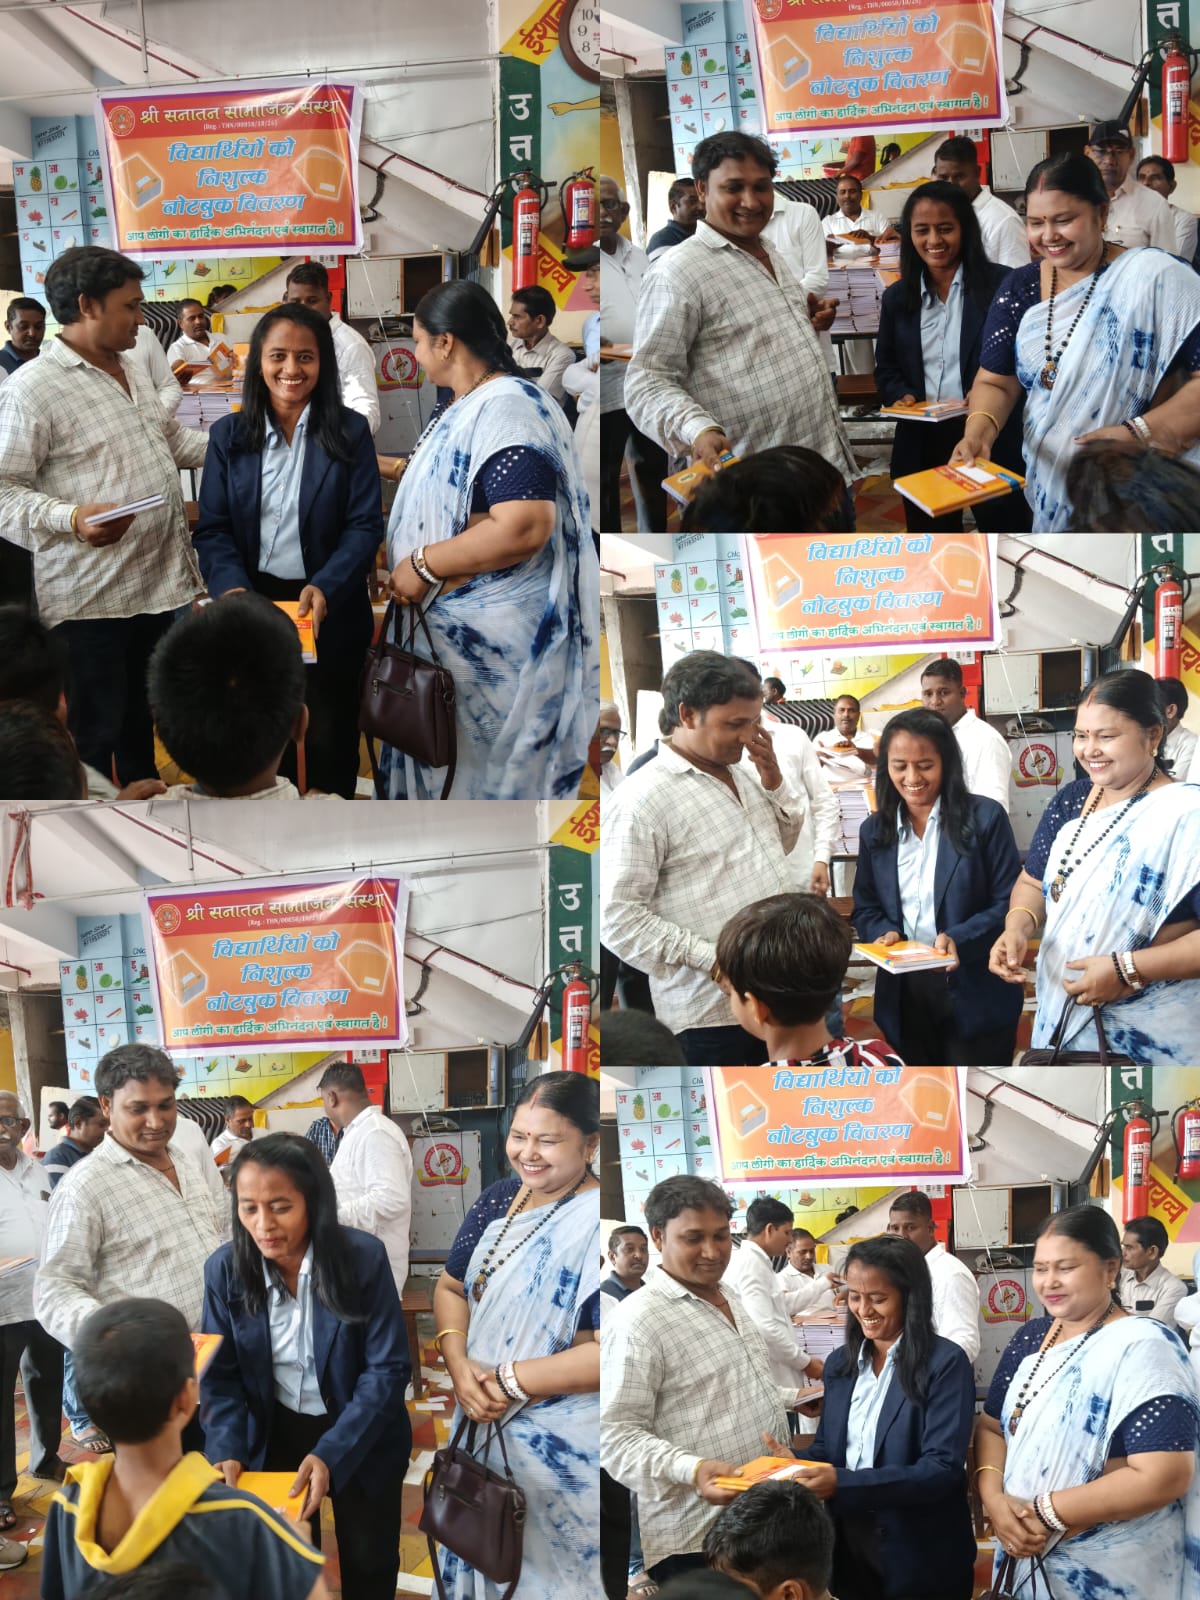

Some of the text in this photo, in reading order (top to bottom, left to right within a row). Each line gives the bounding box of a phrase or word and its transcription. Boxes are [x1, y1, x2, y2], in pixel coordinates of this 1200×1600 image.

[583, 9, 593, 20] 10
[913, 12, 940, 34] को
[578, 25, 587, 36] 9
[582, 41, 590, 52] 8
[593, 53, 600, 64] 7
[844, 47, 912, 70] निशुल्क
[810, 70, 950, 98] नोटबुक वितरण
[140, 106, 159, 124] श्री
[164, 108, 220, 122] सनातन
[819, 109, 834, 118] का
[837, 105, 867, 118] हार्दिक
[937, 99, 970, 110] स्वागत
[269, 137, 296, 157] को
[196, 167, 268, 191] निशुल्क
[161, 192, 306, 219] नोटबुक वितरण
[172, 229, 186, 239] का
[189, 225, 221, 240] हार्दिक
[292, 223, 326, 235] स्वागत
[906, 534, 933, 554] को
[836, 565, 905, 588] निशुल्क
[801, 590, 944, 617] नोटबुक वितरण
[811, 628, 825, 638] का
[828, 624, 859, 639] हार्दिक
[930, 621, 963, 631] स्वागत
[186, 902, 204, 921] श्री
[209, 903, 264, 920] सनातन
[312, 930, 340, 952] को
[241, 963, 312, 986] निशुल्क
[207, 988, 350, 1014] नोटबुक वितरण
[216, 1024, 230, 1035] का
[233, 1020, 264, 1035] हार्दिक
[335, 1018, 370, 1029] स्वागत
[802, 1096, 874, 1120] निशुल्क
[767, 1122, 912, 1148] नोटबुक वितरण
[776, 1158, 791, 1168] का
[794, 1155, 826, 1169] हार्दिक
[898, 1153, 932, 1164] स्वागत
